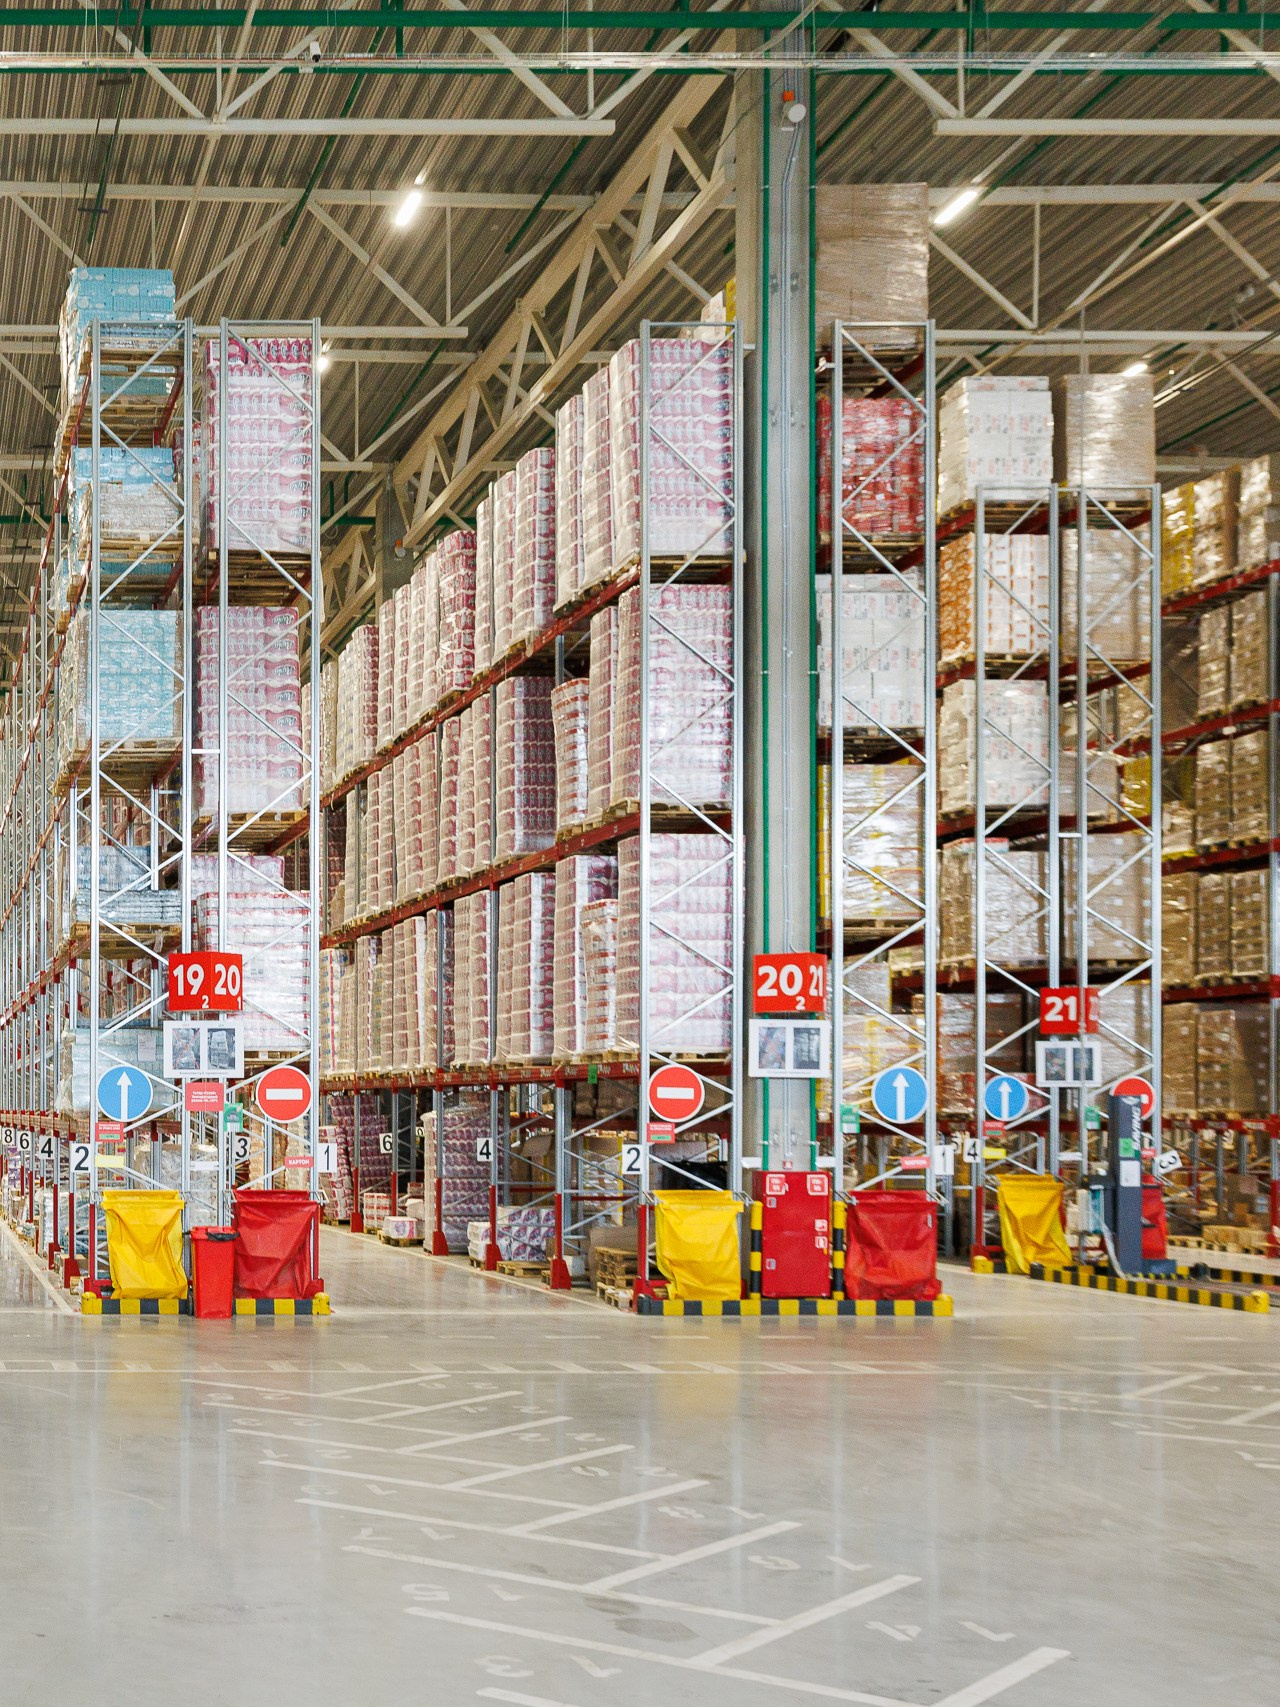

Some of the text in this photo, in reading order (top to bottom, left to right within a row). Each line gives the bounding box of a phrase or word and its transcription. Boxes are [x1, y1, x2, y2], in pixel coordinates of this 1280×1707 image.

[173, 964, 204, 996] 19
[214, 964, 240, 996] 20
[757, 964, 803, 996] 20
[809, 964, 823, 996] 21
[202, 995, 209, 1008] 2
[237, 996, 241, 1010] 1
[796, 996, 806, 1010] 2
[1044, 996, 1078, 1022] 21
[4, 1129, 12, 1143] 8
[20, 1132, 30, 1149] 6
[383, 1136, 392, 1151] 6
[41, 1138, 53, 1158] 4
[74, 1146, 89, 1170] 2
[236, 1138, 247, 1158] 3
[480, 1140, 491, 1160] 4
[968, 1142, 978, 1160] 4
[324, 1148, 330, 1170] 1
[626, 1148, 640, 1172] 2
[942, 1148, 946, 1172] 1
[1159, 1155, 1177, 1170] 3
[262, 1448, 353, 1460] 21
[570, 1464, 678, 1479] 20
[300, 1483, 398, 1496] 19
[656, 1504, 766, 1521] 18
[355, 1526, 456, 1541] 17
[746, 1553, 872, 1572] 16
[401, 1582, 523, 1602] 15
[864, 1619, 1016, 1643] 14
[473, 1654, 623, 1678] 13
